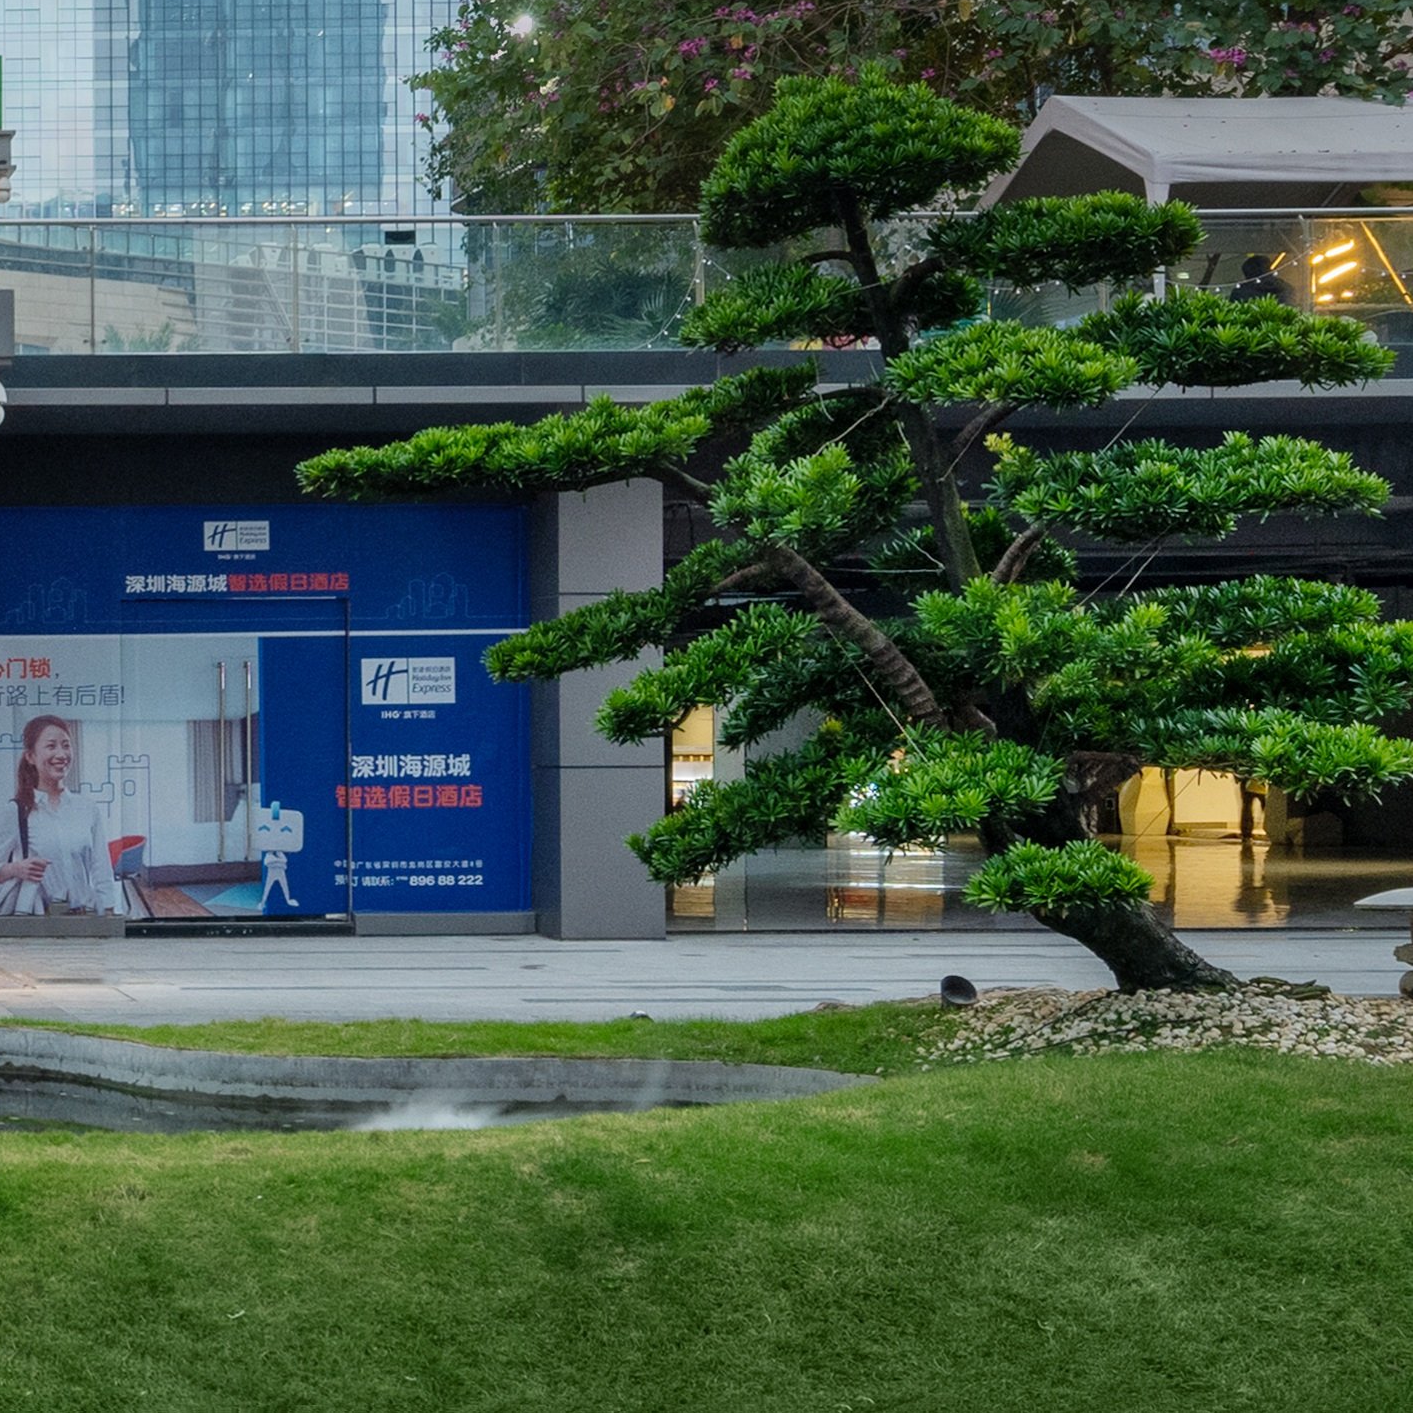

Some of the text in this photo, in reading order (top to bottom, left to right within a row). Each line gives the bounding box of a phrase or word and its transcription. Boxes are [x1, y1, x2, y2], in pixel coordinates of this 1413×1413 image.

[412, 682, 452, 694] Express
[351, 754, 471, 778] 深圳海源城
[335, 784, 483, 809] 智选假日酒店
[409, 875, 436, 886] 896
[437, 875, 455, 886] 88
[458, 874, 484, 885] 222
